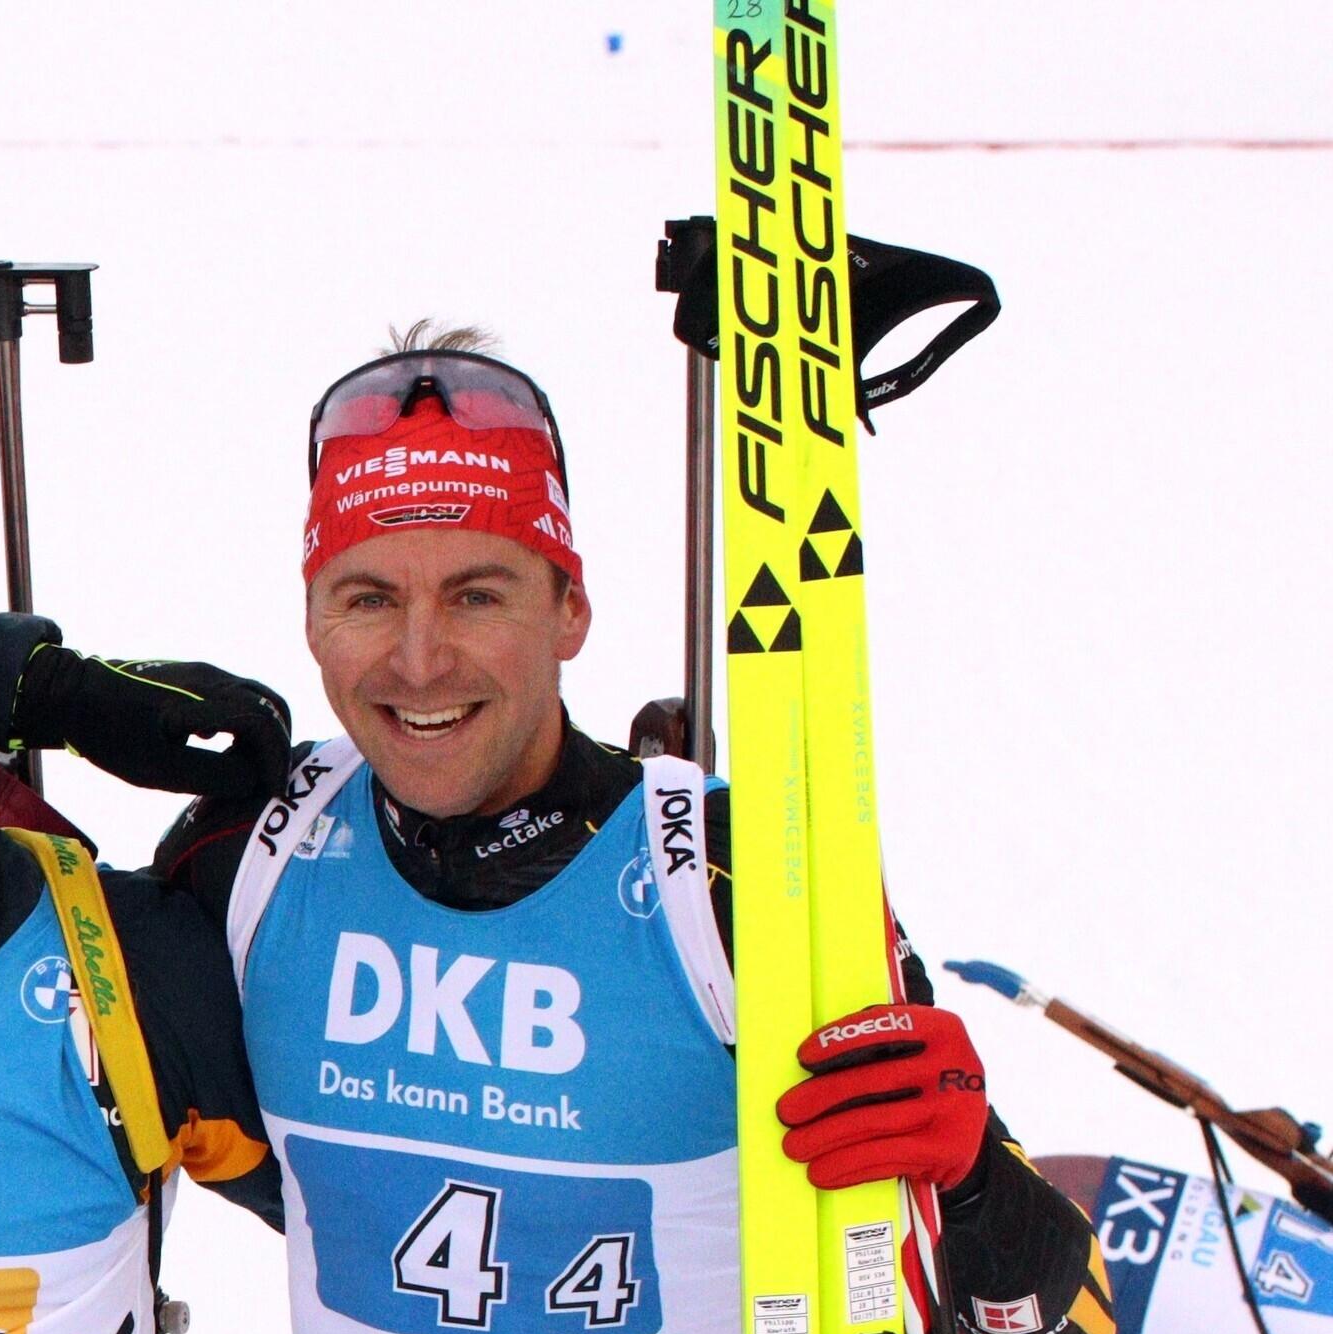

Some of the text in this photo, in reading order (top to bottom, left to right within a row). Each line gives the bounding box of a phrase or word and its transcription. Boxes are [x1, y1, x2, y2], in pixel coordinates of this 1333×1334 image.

[726, 28, 785, 524] FISCHER
[336, 447, 511, 485] VIESSMANN
[337, 480, 508, 513] Wärmepumpen
[258, 764, 333, 857] JOKA
[475, 809, 564, 858] tectake
[655, 788, 697, 877] JOKA
[35, 960, 67, 975] BM
[324, 931, 587, 1075] DKB
[318, 1061, 581, 1131] Das kann Bank
[392, 1178, 641, 1331] 4 4
[1098, 1164, 1177, 1266] iX3
